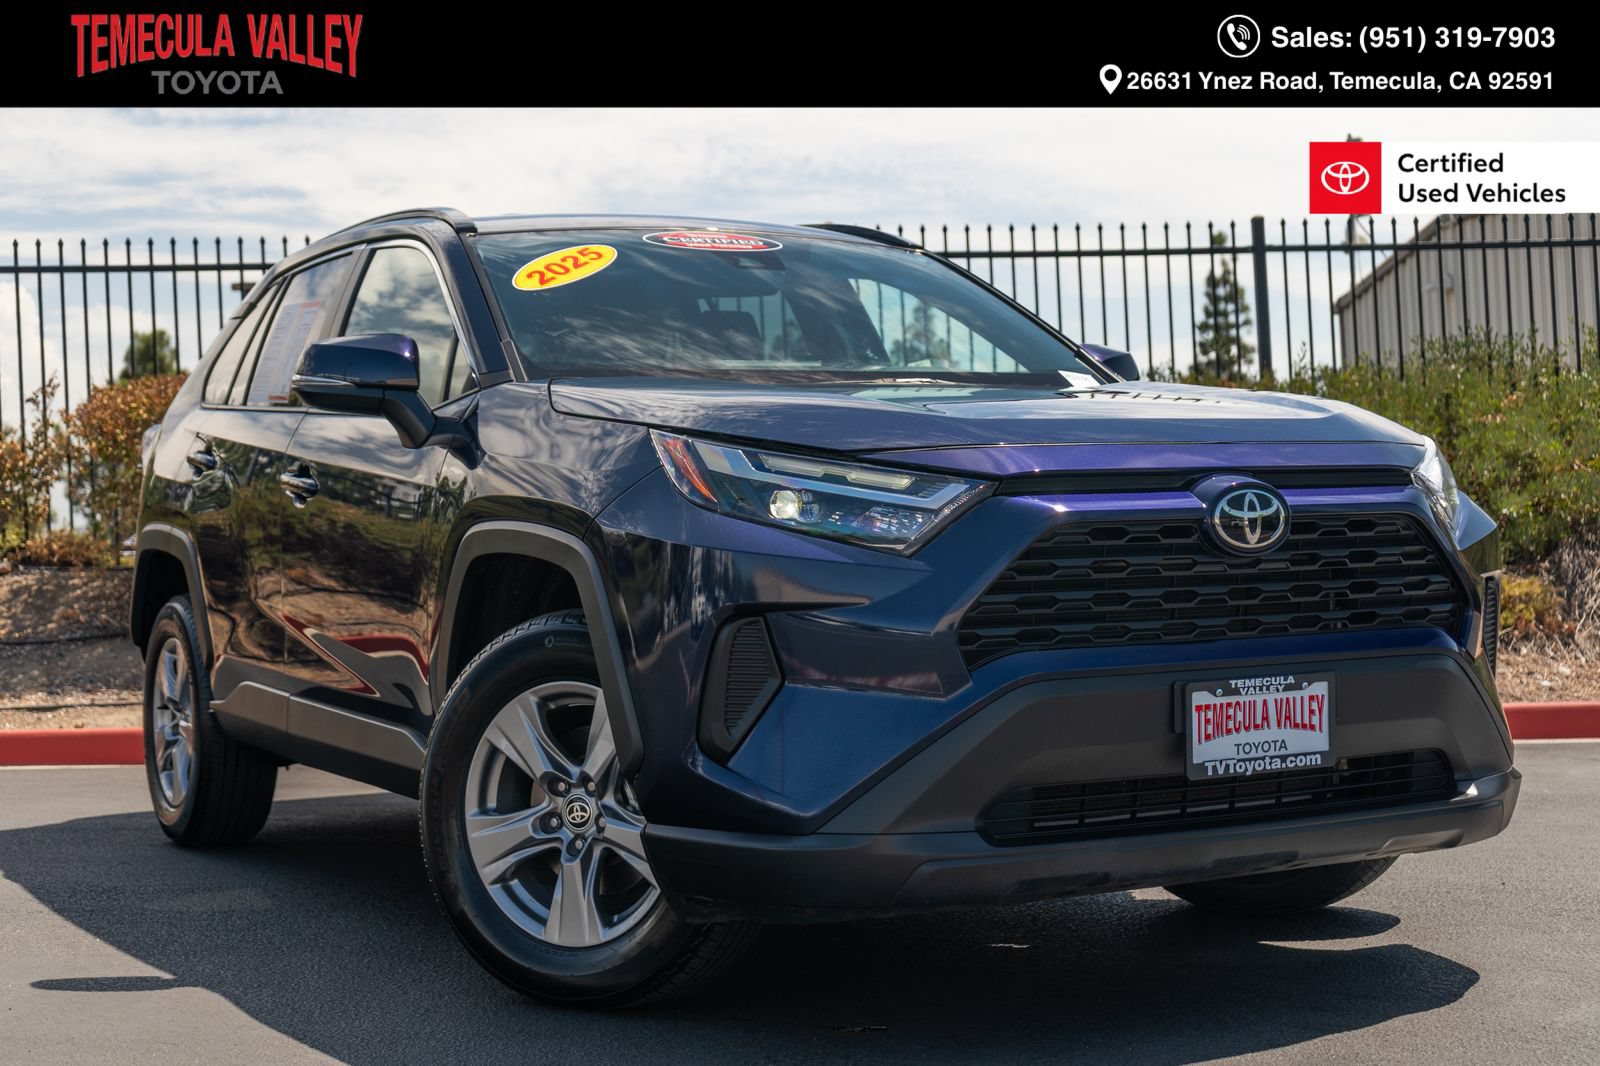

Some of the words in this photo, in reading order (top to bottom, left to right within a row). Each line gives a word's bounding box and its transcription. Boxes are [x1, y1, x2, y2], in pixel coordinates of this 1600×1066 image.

[526, 247, 602, 285] 2025
[1229, 675, 1295, 688] TEMECULA
[1240, 685, 1285, 696] VALLEY
[1195, 698, 1271, 745] TEMECULA
[1274, 694, 1325, 733] VALLEY
[1234, 739, 1288, 755] TOYOTA
[1204, 753, 1322, 776] TVToyota.com
